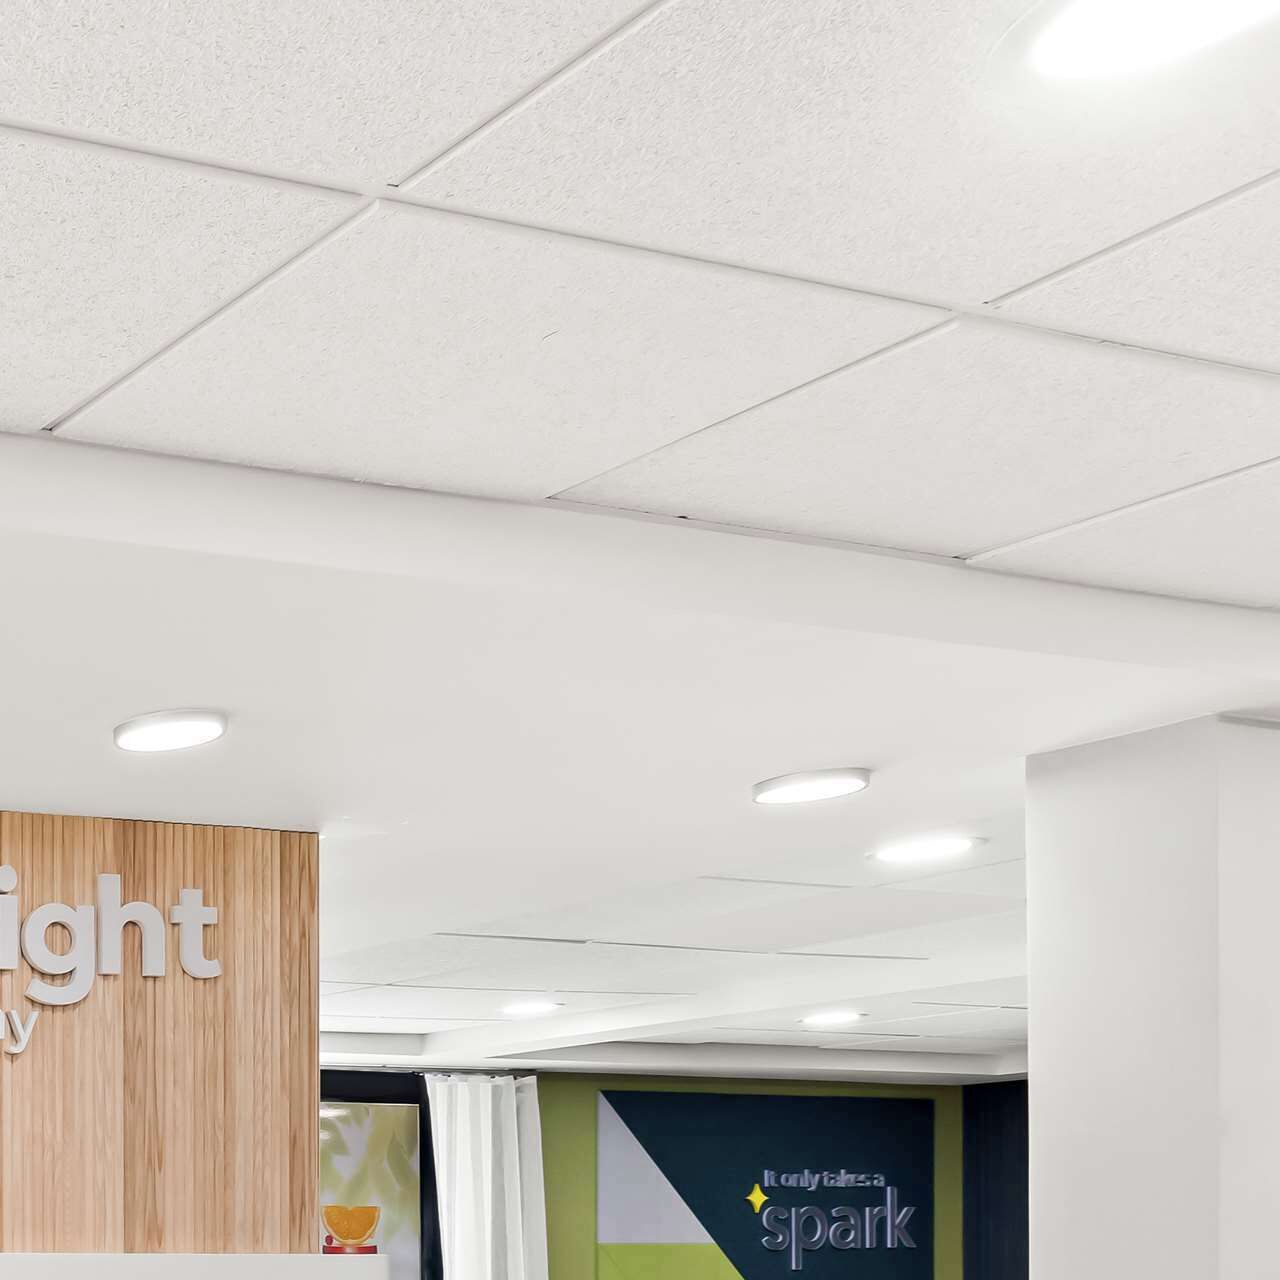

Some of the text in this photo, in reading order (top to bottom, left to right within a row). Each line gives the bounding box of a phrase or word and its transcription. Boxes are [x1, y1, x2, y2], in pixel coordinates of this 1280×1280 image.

[763, 1169, 886, 1191] It only takes a
[761, 1186, 918, 1270] spark
